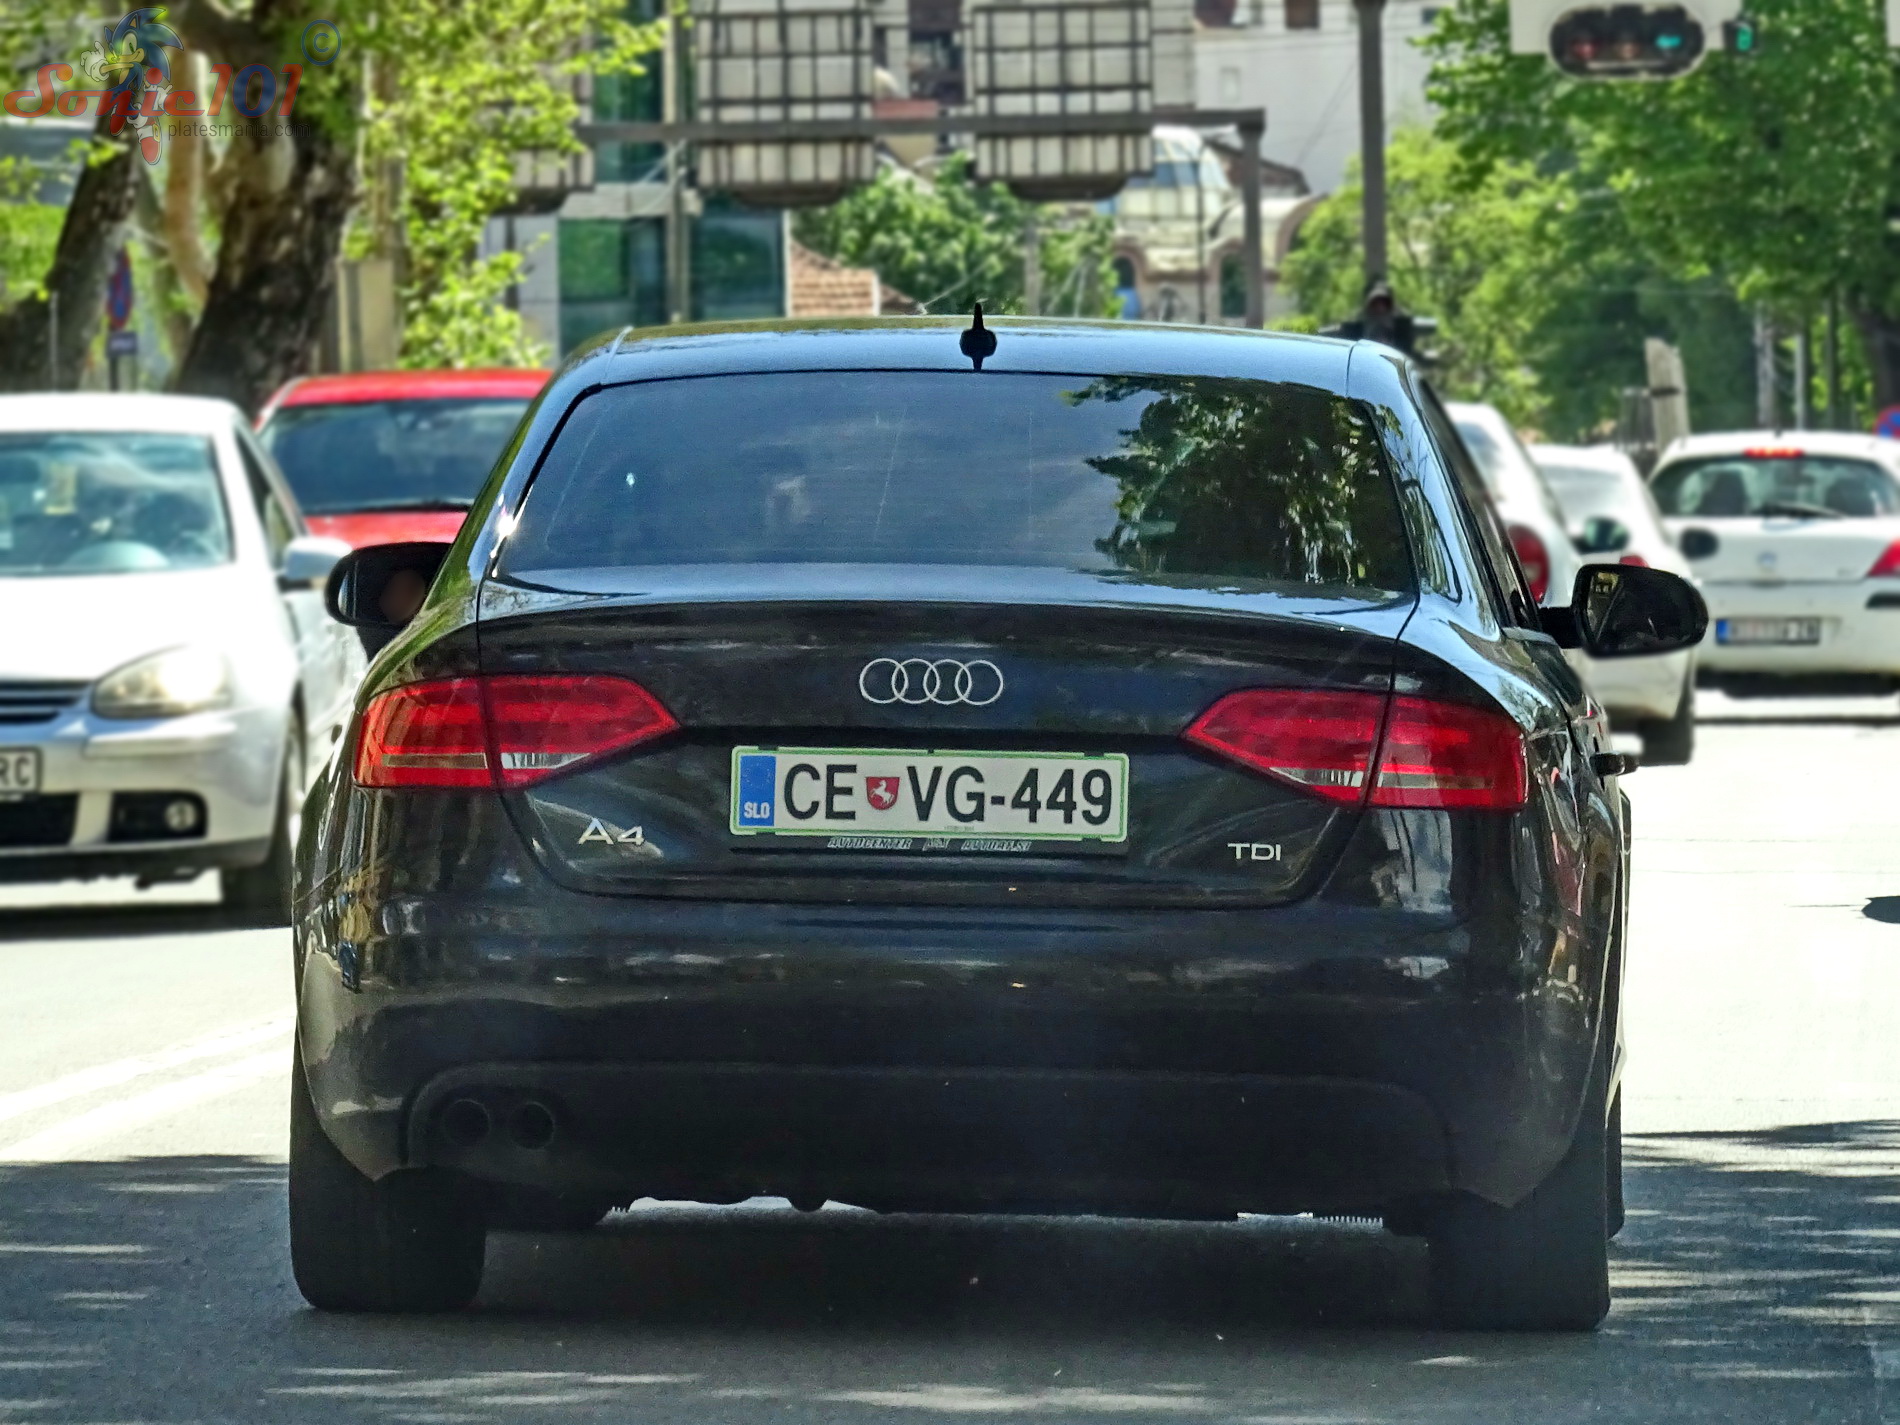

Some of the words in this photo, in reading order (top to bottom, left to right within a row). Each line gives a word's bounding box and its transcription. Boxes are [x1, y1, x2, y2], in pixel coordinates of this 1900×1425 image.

[784, 763, 857, 820] CE
[907, 766, 1112, 825] VG-449
[743, 801, 770, 819] SLO
[578, 818, 644, 845] A4
[1227, 843, 1281, 861] TDI
